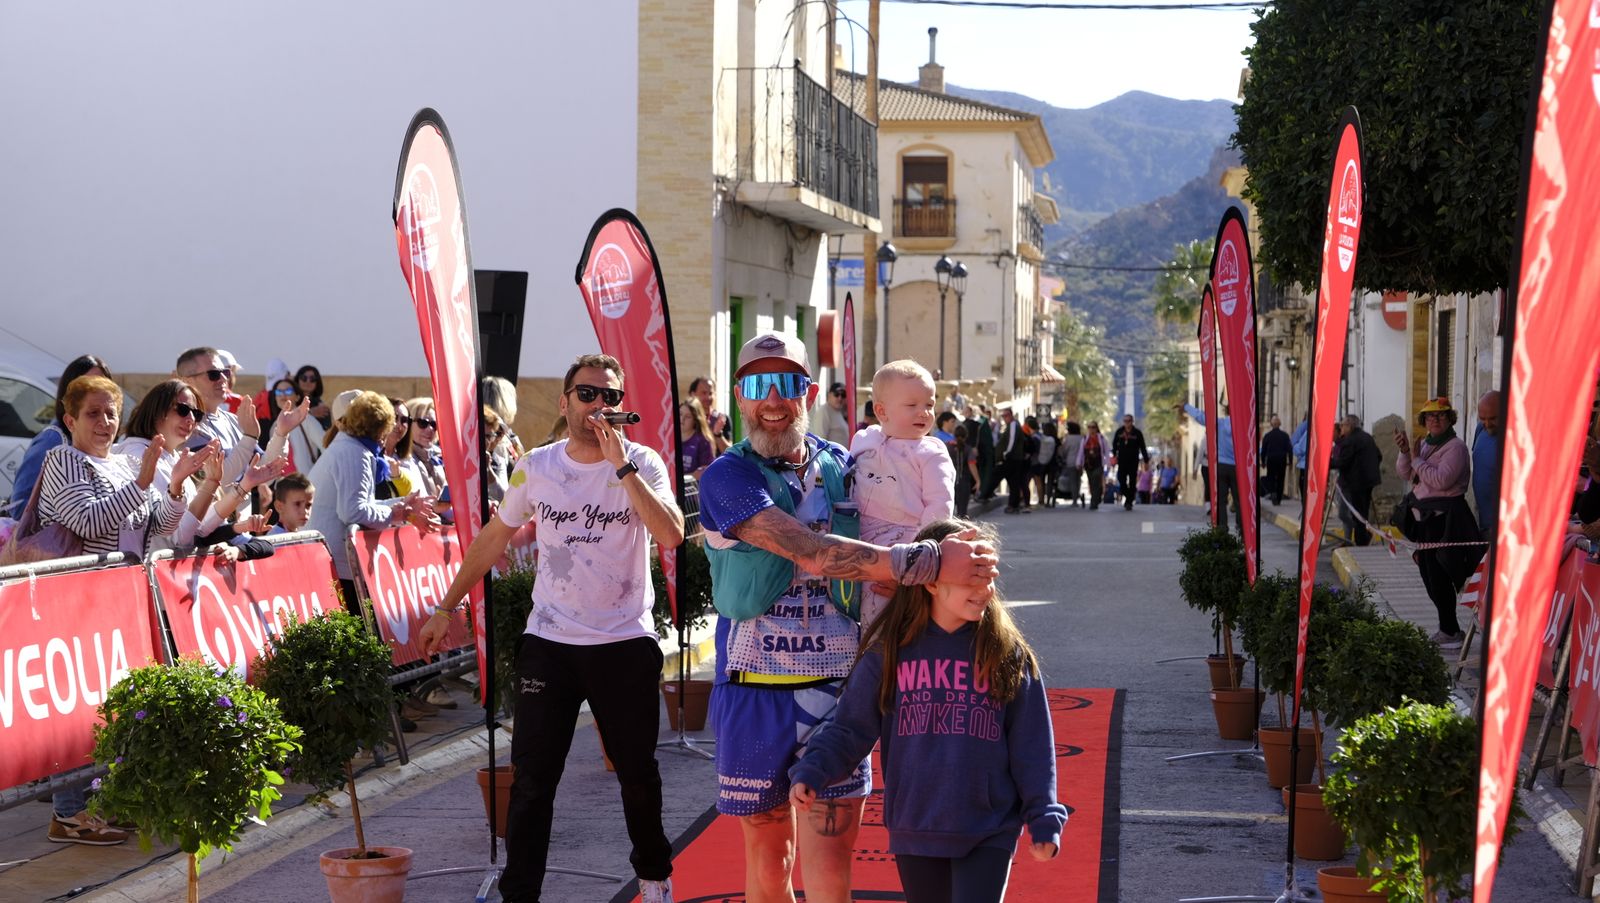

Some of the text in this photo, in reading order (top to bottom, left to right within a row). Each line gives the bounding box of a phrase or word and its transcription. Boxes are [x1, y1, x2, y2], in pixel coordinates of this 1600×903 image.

[537, 501, 631, 531] Pepe Yepes
[564, 532, 603, 546] speaker
[762, 634, 827, 653] SALAS
[896, 658, 969, 693] WAKE
[901, 690, 1001, 711] AND DREAM
[718, 774, 773, 789] TRAFONDO
[719, 789, 761, 802] ALMERIA
